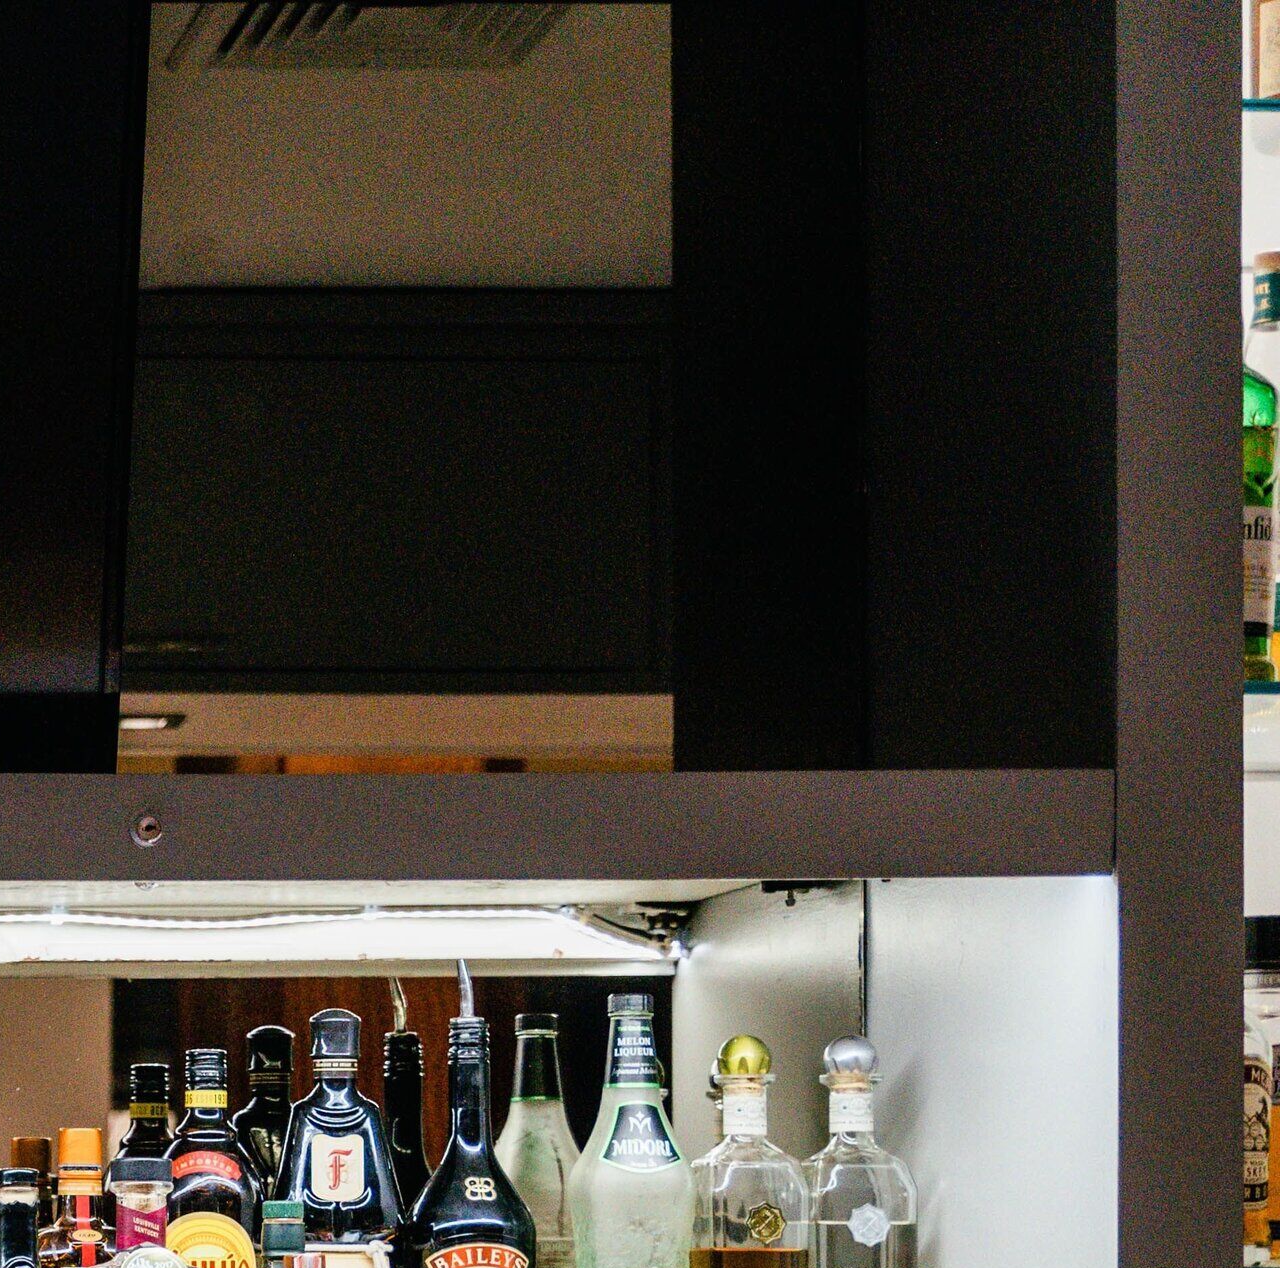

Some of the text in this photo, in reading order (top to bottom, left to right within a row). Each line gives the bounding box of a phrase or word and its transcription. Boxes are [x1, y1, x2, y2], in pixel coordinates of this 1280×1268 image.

[616, 1036, 652, 1047] MELON
[613, 1047, 655, 1058] LIQUEUR
[610, 1138, 672, 1157] MIDORI
